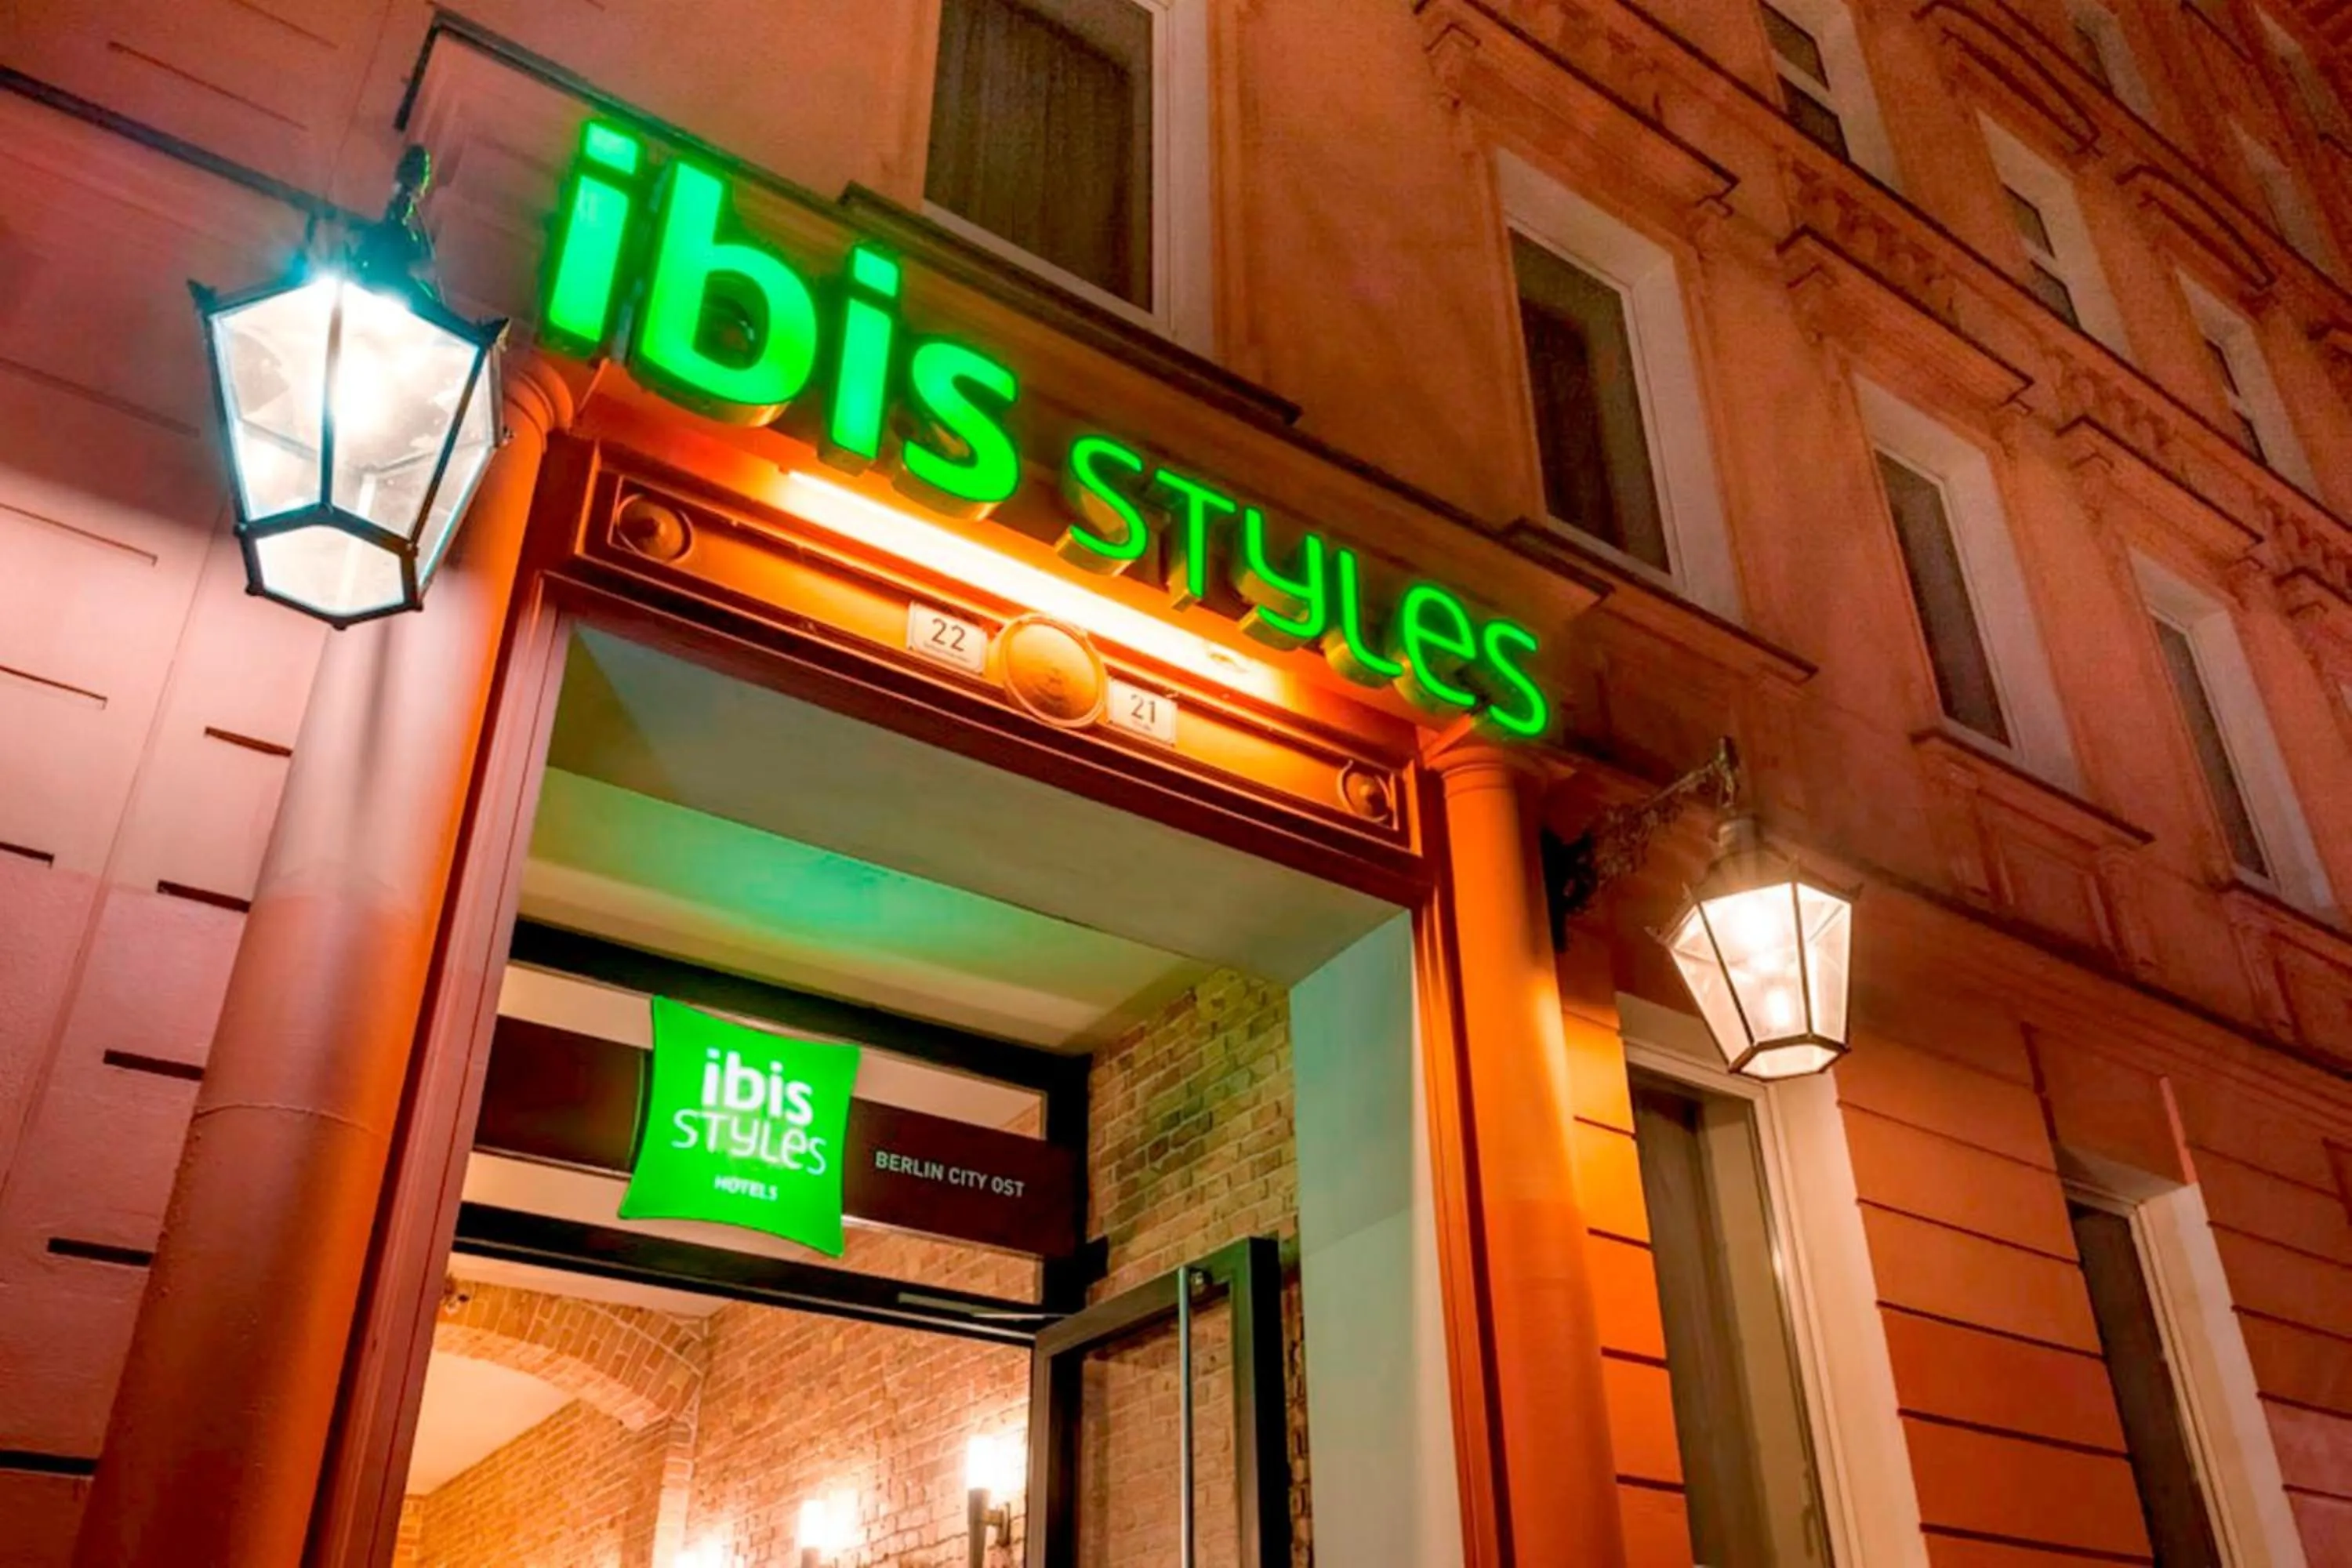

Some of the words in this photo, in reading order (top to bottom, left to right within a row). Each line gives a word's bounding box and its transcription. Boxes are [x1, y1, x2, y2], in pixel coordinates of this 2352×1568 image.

[548, 120, 1020, 503] ibis
[931, 617, 966, 652] 22
[1130, 693, 1156, 724] 21
[701, 1047, 814, 1126] ibis
[714, 1174, 779, 1201] HOTELS
[874, 1150, 945, 1181] BERLIN
[948, 1167, 989, 1190] CITY
[991, 1176, 1025, 1198] OST
